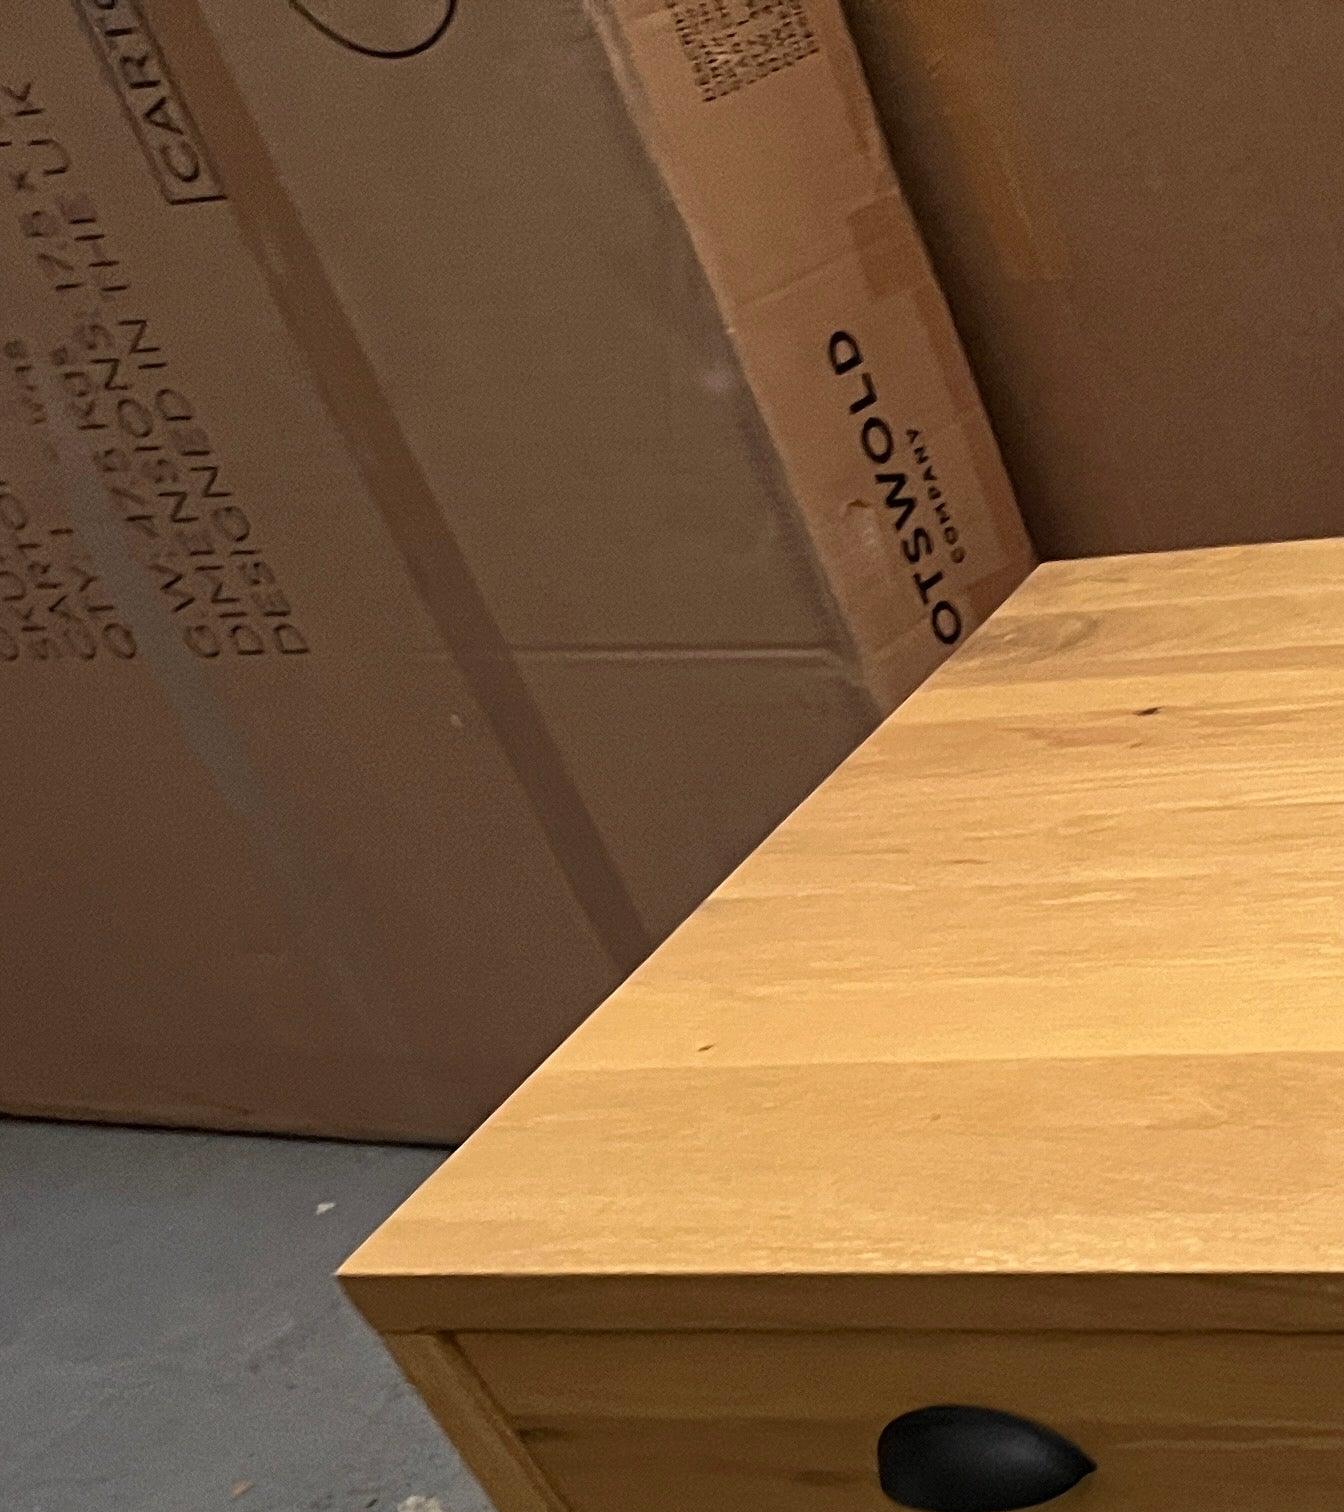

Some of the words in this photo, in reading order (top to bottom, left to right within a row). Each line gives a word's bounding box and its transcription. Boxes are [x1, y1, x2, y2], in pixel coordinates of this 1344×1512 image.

[57, 195, 131, 299] THE
[117, 319, 167, 370] IN
[155, 388, 309, 657] DESIGNED
[828, 331, 963, 643] OTSWOLD
[906, 428, 966, 564] COMPANY
[0, 480, 97, 660] CARTO
